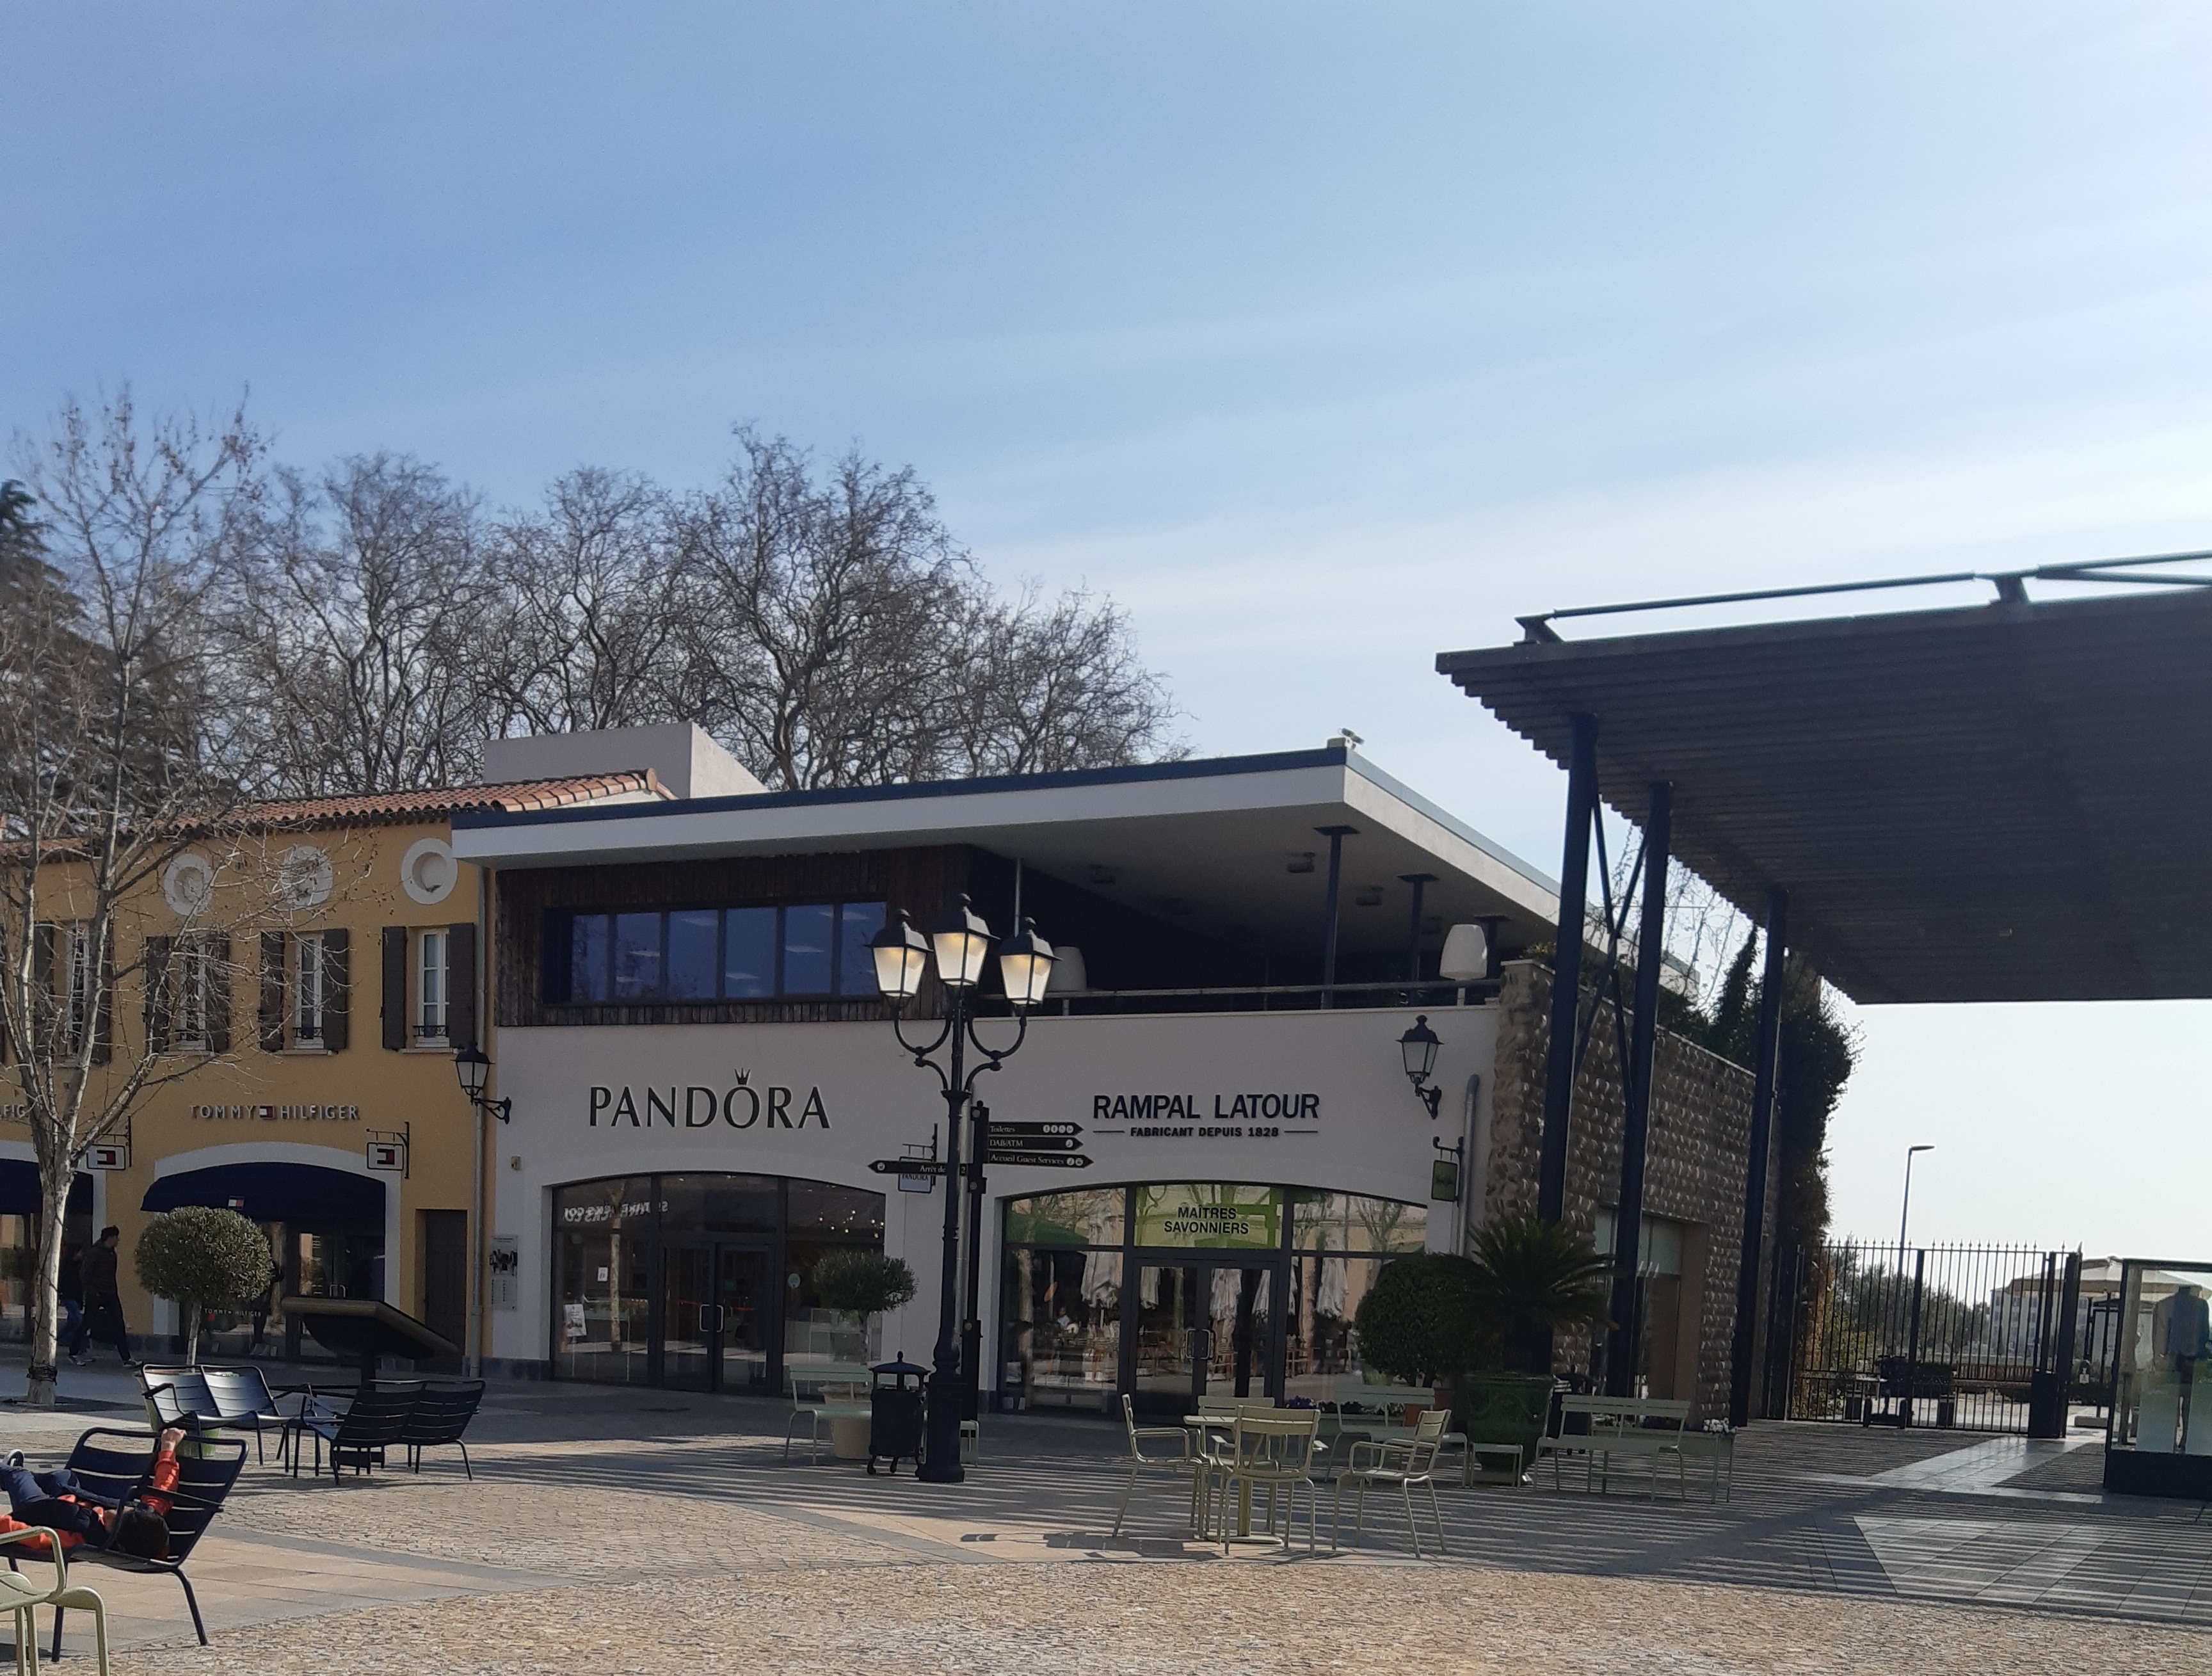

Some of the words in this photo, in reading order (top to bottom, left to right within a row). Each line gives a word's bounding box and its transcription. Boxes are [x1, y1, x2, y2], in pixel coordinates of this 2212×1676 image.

[189, 1106, 255, 1119] TOMMY
[280, 1104, 358, 1120] HILFIGER
[589, 1086, 831, 1129] PANDORA
[1093, 1094, 1201, 1119] RAMPAL
[1214, 1093, 1320, 1119] LATOUR
[1130, 1127, 1194, 1137] FABRICANT
[1198, 1127, 1243, 1137] DEPUIS
[1248, 1127, 1279, 1138] 1828
[990, 1139, 1023, 1147] DAB/ATM
[991, 1154, 1015, 1163] Accueil
[1016, 1155, 1036, 1163] Guest
[1038, 1156, 1064, 1164] Services
[1178, 1204, 1237, 1220] MAÎTRES
[1164, 1221, 1249, 1235] SAVONNIERS
